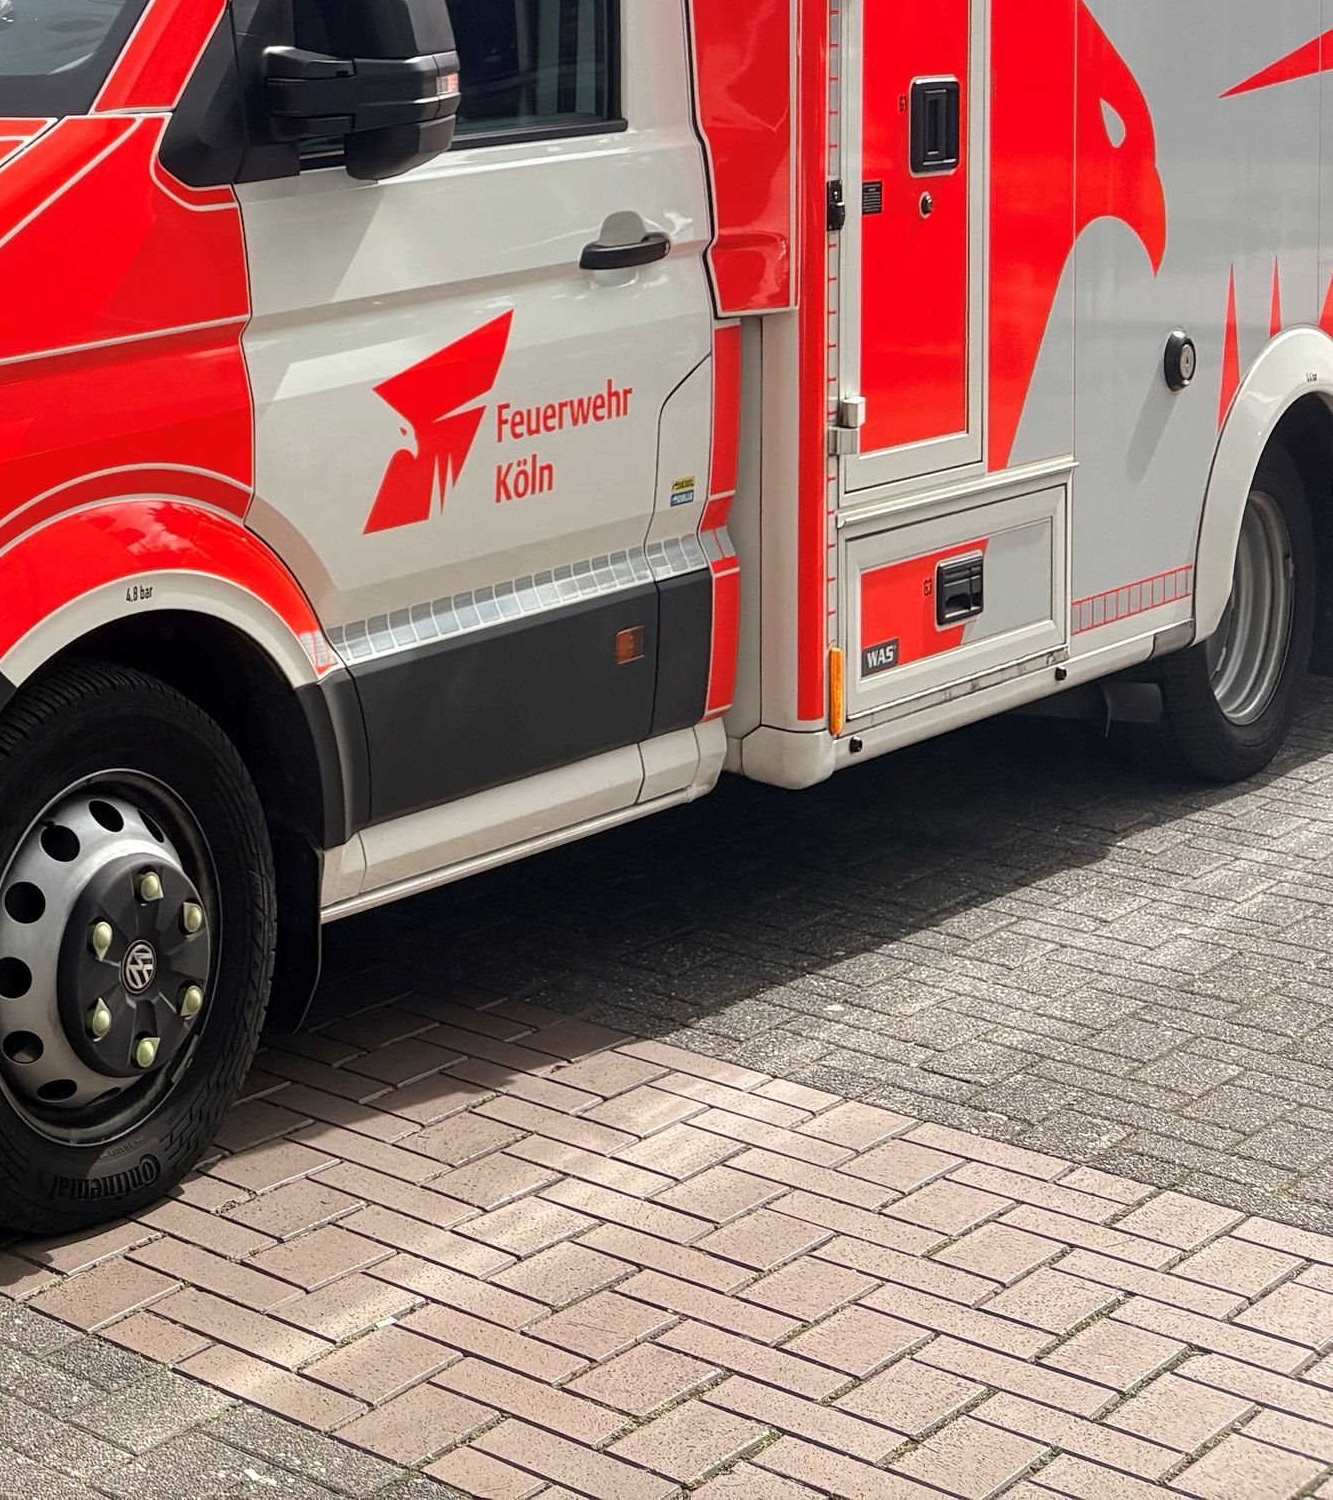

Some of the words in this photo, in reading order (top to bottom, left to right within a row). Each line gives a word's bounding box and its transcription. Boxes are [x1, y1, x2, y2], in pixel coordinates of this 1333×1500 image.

[497, 378, 633, 443] Feuerwehr
[495, 453, 554, 504] Köln
[140, 585, 153, 599] bar
[867, 645, 894, 669] WAS
